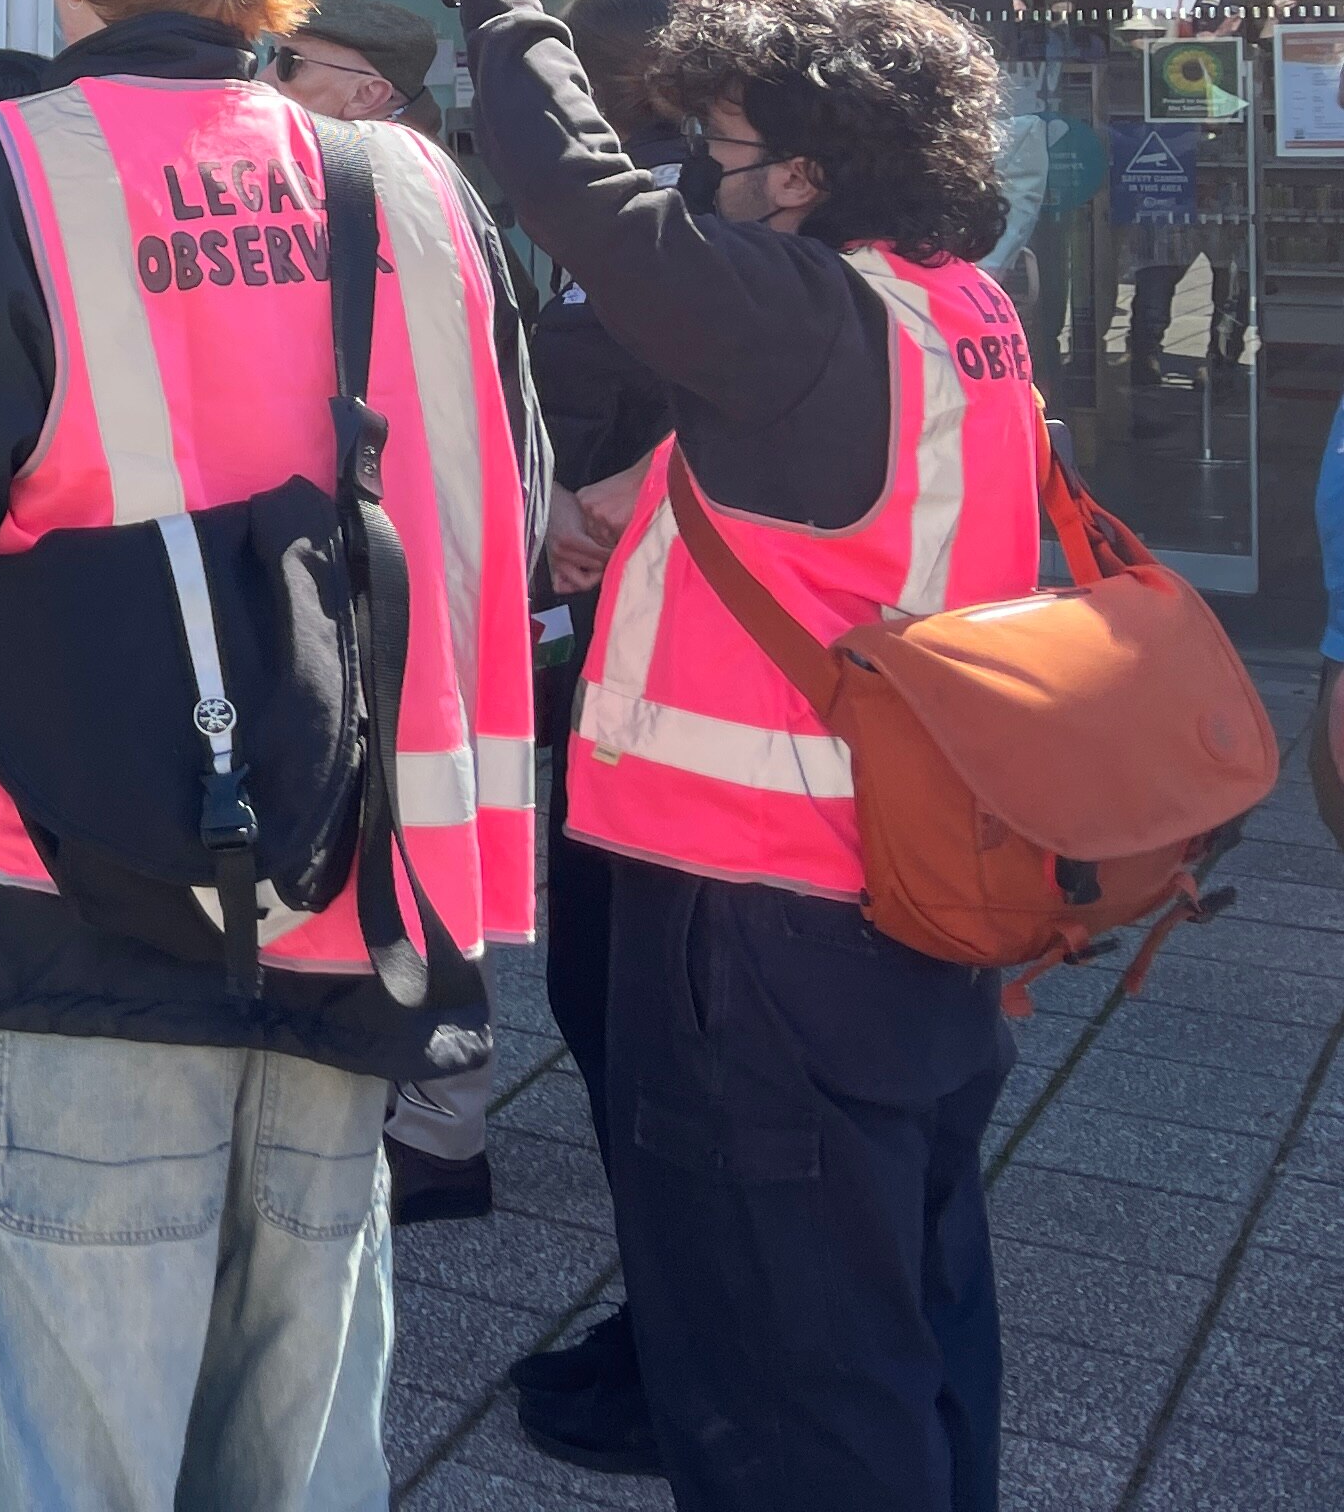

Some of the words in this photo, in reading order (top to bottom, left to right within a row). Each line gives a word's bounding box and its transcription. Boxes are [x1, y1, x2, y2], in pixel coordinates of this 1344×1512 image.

[163, 158, 327, 221] LEGAL
[137, 221, 394, 294] OBSERV
[957, 281, 1017, 324] LE
